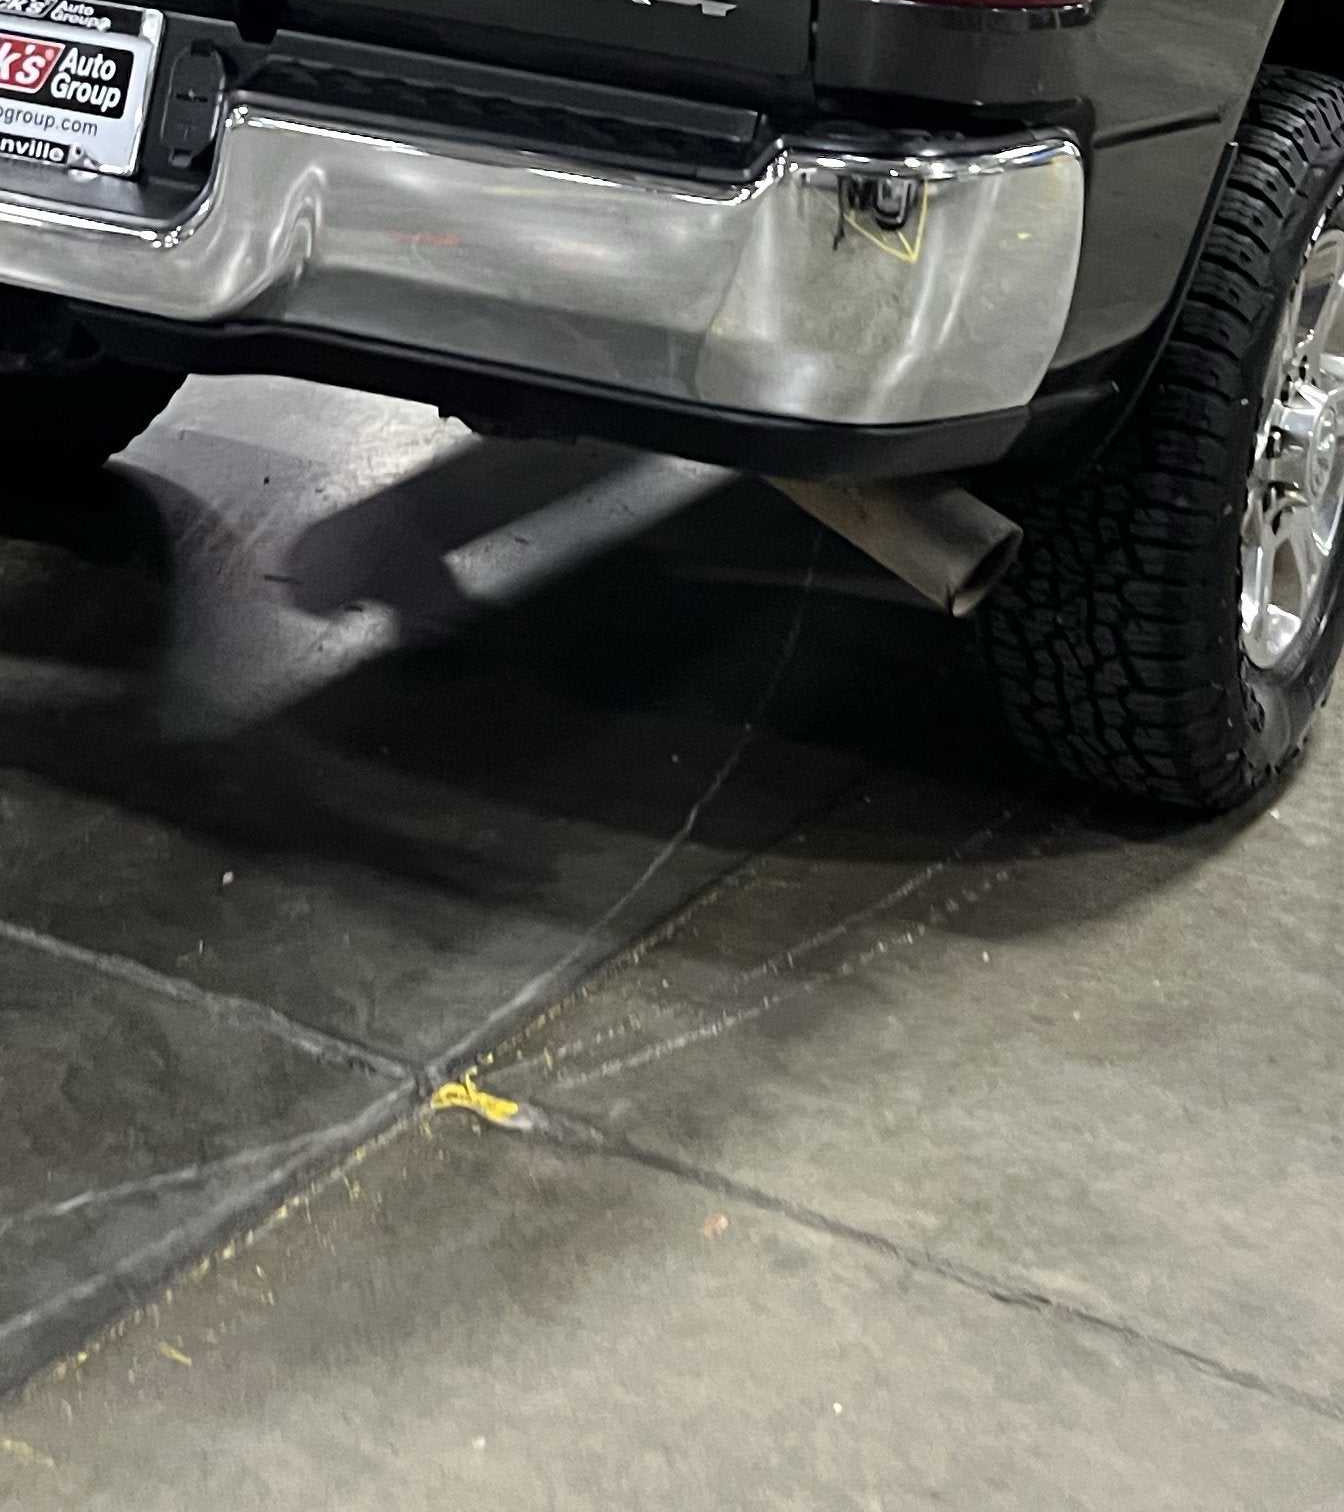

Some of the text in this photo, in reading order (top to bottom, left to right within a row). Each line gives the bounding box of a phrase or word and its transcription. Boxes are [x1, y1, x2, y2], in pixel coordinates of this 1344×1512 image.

[55, 0, 95, 16] Auto
[58, 47, 117, 81] Auto
[50, 74, 122, 113] Group
